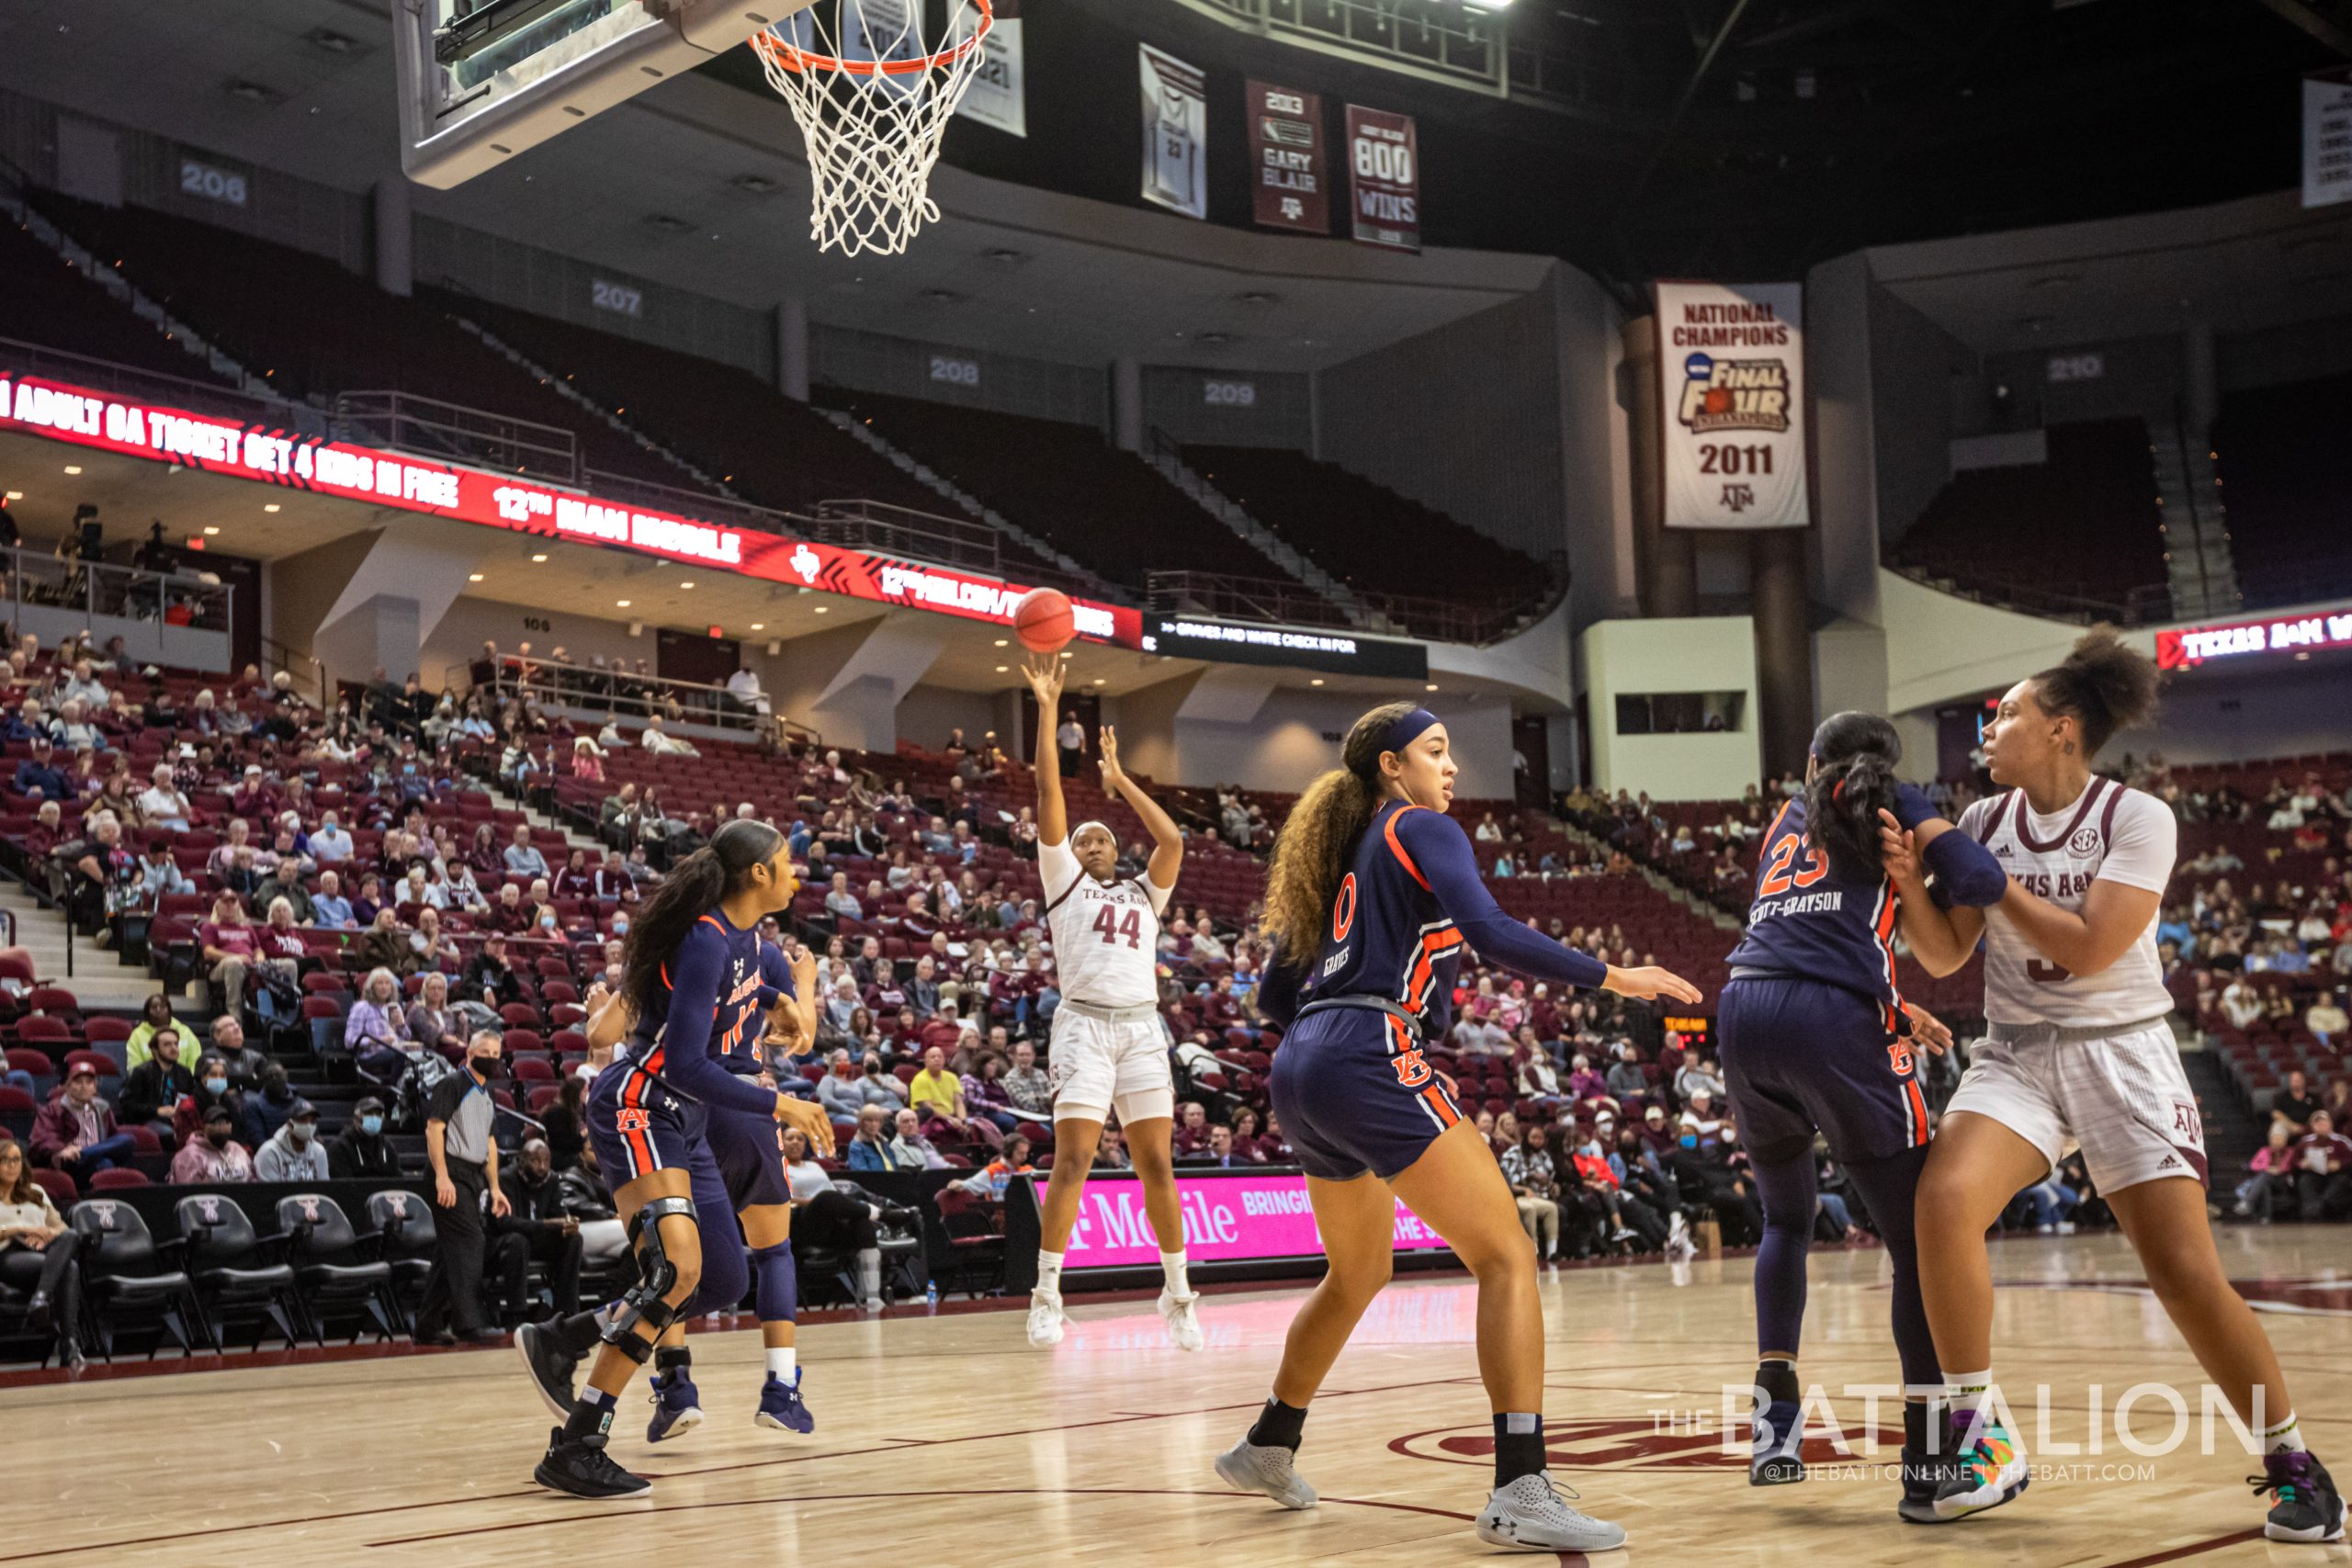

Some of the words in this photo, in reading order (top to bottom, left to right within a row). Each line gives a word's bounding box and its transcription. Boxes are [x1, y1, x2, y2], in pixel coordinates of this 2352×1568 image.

[1263, 147, 1312, 172] GARY
[1354, 137, 1412, 184] 800
[183, 164, 246, 206] 206
[1262, 167, 1317, 193] BLAIR
[1358, 188, 1416, 223] WINS
[594, 281, 641, 313] 207
[1683, 304, 1775, 324] NATIONAL
[1672, 325, 1789, 347] CHAMPIONS
[1710, 360, 1785, 389] FINAL
[295, 444, 313, 479] 4
[1701, 445, 1773, 475] 2011
[2181, 626, 2266, 659] TEXAS
[2073, 830, 2097, 852] SEC
[1333, 872, 1356, 942] 0
[1092, 904, 1141, 950] 44
[1323, 946, 1351, 977] GRAVES
